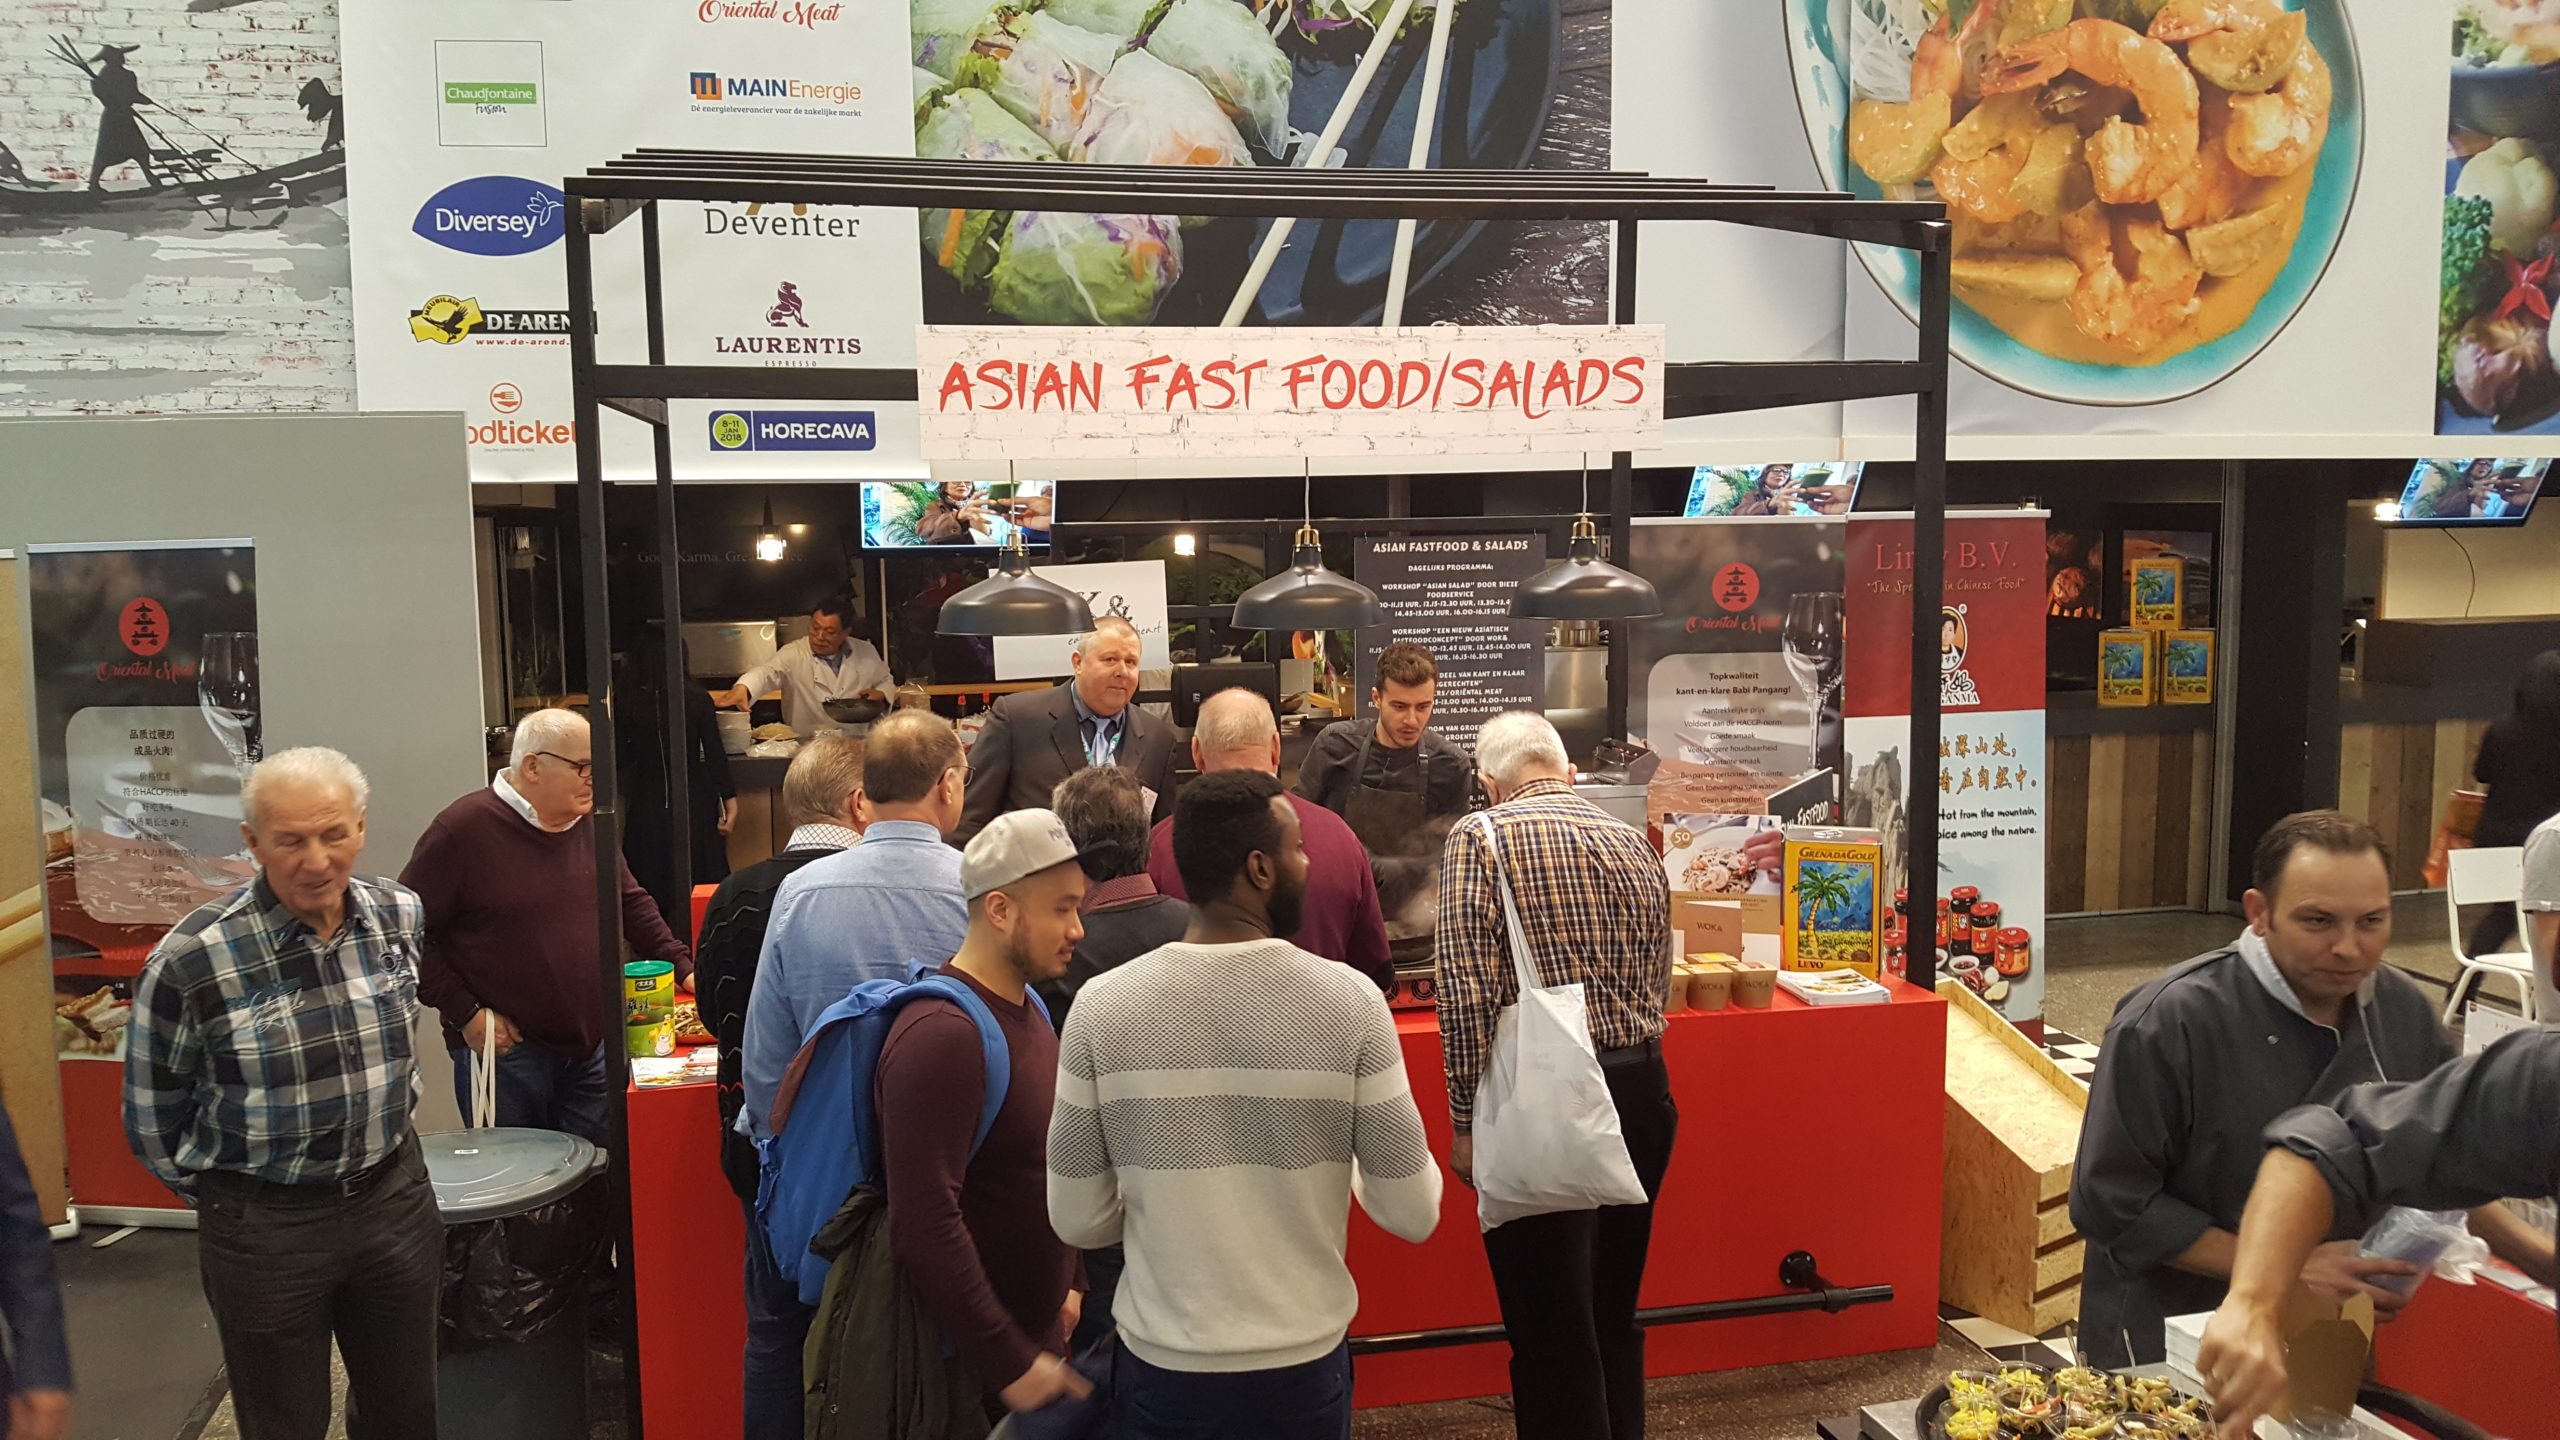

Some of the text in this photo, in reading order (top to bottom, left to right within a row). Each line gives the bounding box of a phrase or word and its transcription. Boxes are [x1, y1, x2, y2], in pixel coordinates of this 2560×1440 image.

[698, 0, 846, 30] Oriental Meat
[447, 87, 533, 101] Chaudfontaine
[728, 78, 861, 104] MAINEnergie
[475, 102, 507, 115] Fusion
[702, 104, 774, 115] energieleverancier
[793, 107, 803, 115] de
[804, 108, 837, 118] zakelijke
[838, 109, 862, 117] markt
[436, 208, 537, 238] Diversey
[704, 208, 860, 237] Deventer
[424, 297, 461, 316] MEUBILAIR
[517, 313, 570, 330] AREN
[475, 338, 570, 346] www.de-arend.
[715, 337, 862, 354] LAURENTIS
[765, 360, 817, 368] ESPRESSO
[938, 351, 1647, 419] ASIAN FAST FOOD/SALADS
[722, 420, 740, 428] 8-11
[761, 423, 869, 439] HORECAVA
[720, 433, 742, 441] 2018
[1373, 540, 1529, 552] ASIAN FASTFOOD & SALADS
[1959, 541, 2017, 569] B.V.
[1446, 563, 1494, 571] PROGRAMMA:
[1957, 578, 1993, 591] Chinese
[1477, 598, 1511, 606] 13.30-13.4
[1392, 627, 1431, 635] WORKSHOP
[1451, 626, 1473, 634] NIEUW
[1517, 642, 1532, 650] UUR
[1489, 652, 1504, 660] UUR
[1473, 670, 1491, 678] KANT
[1503, 669, 1526, 677] KLAAR
[1709, 672, 1760, 681] Topkwaliteit
[1436, 680, 1483, 688] GERECHTEN"
[1435, 688, 1483, 697] RS/ORIËNTAL
[1676, 685, 1791, 696] kant-en-klare Babi Pangang!
[1702, 706, 1765, 715] Aantrekkelijke prijs
[1683, 719, 1711, 728] Voldoet
[1726, 719, 1735, 727] de
[1733, 732, 1756, 740] smaak
[1687, 744, 1778, 754] Veel langere houdbaarheid
[1703, 757, 1761, 766] Constante smaak
[1680, 772, 1715, 780] Besparing
[1716, 771, 1749, 779] personeel
[1720, 796, 1762, 804] kunststoffen
[1960, 809, 1978, 820] from
[1981, 807, 1995, 818] the
[1997, 806, 2037, 817] mountain,
[1961, 829, 1988, 839] among
[1992, 826, 2005, 837] the
[2008, 827, 2037, 836] nature.
[1674, 831, 1690, 844] 50
[1797, 960, 1824, 969] LUVO
